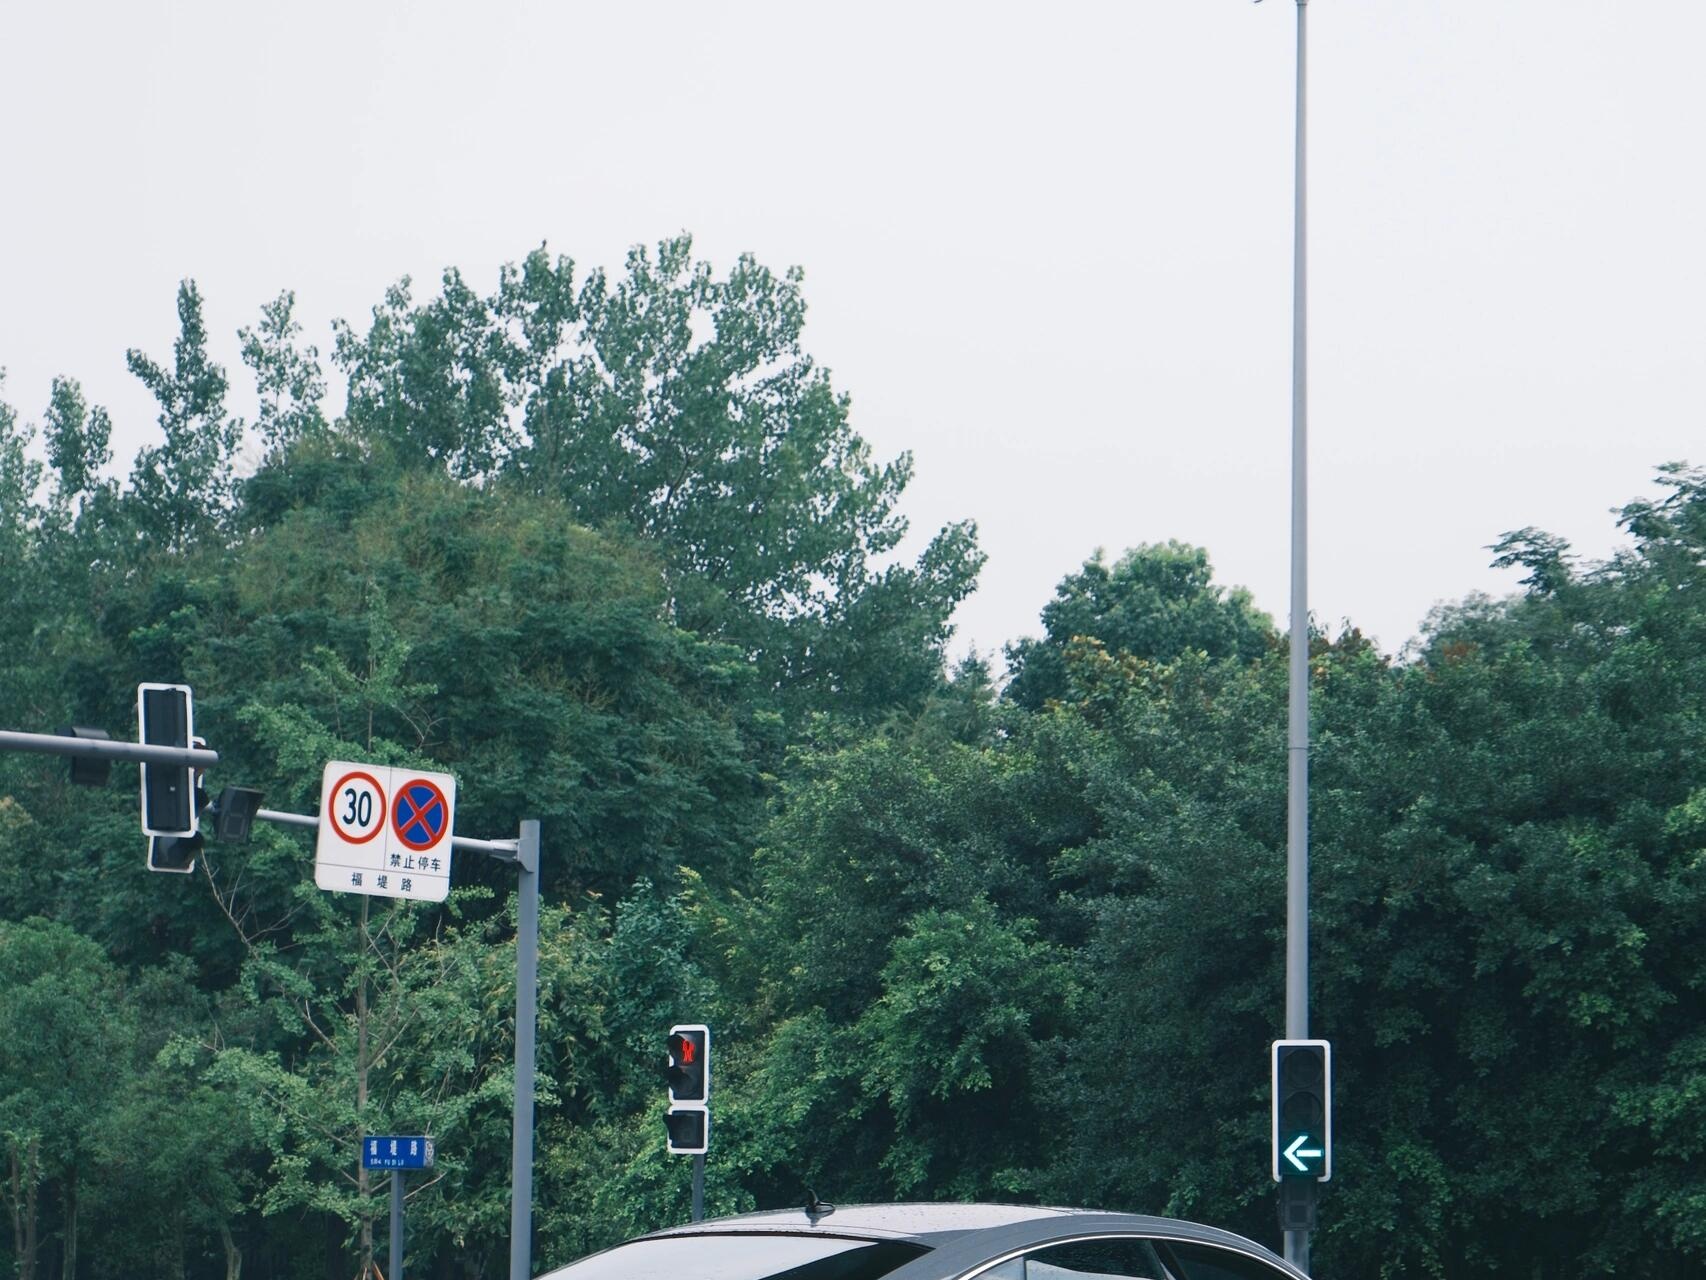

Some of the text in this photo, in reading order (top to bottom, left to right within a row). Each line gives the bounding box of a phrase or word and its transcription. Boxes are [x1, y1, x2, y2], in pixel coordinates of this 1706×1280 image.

[342, 788, 372, 827] 30
[390, 853, 441, 872] 禁止停车
[351, 872, 412, 892] 福堤路
